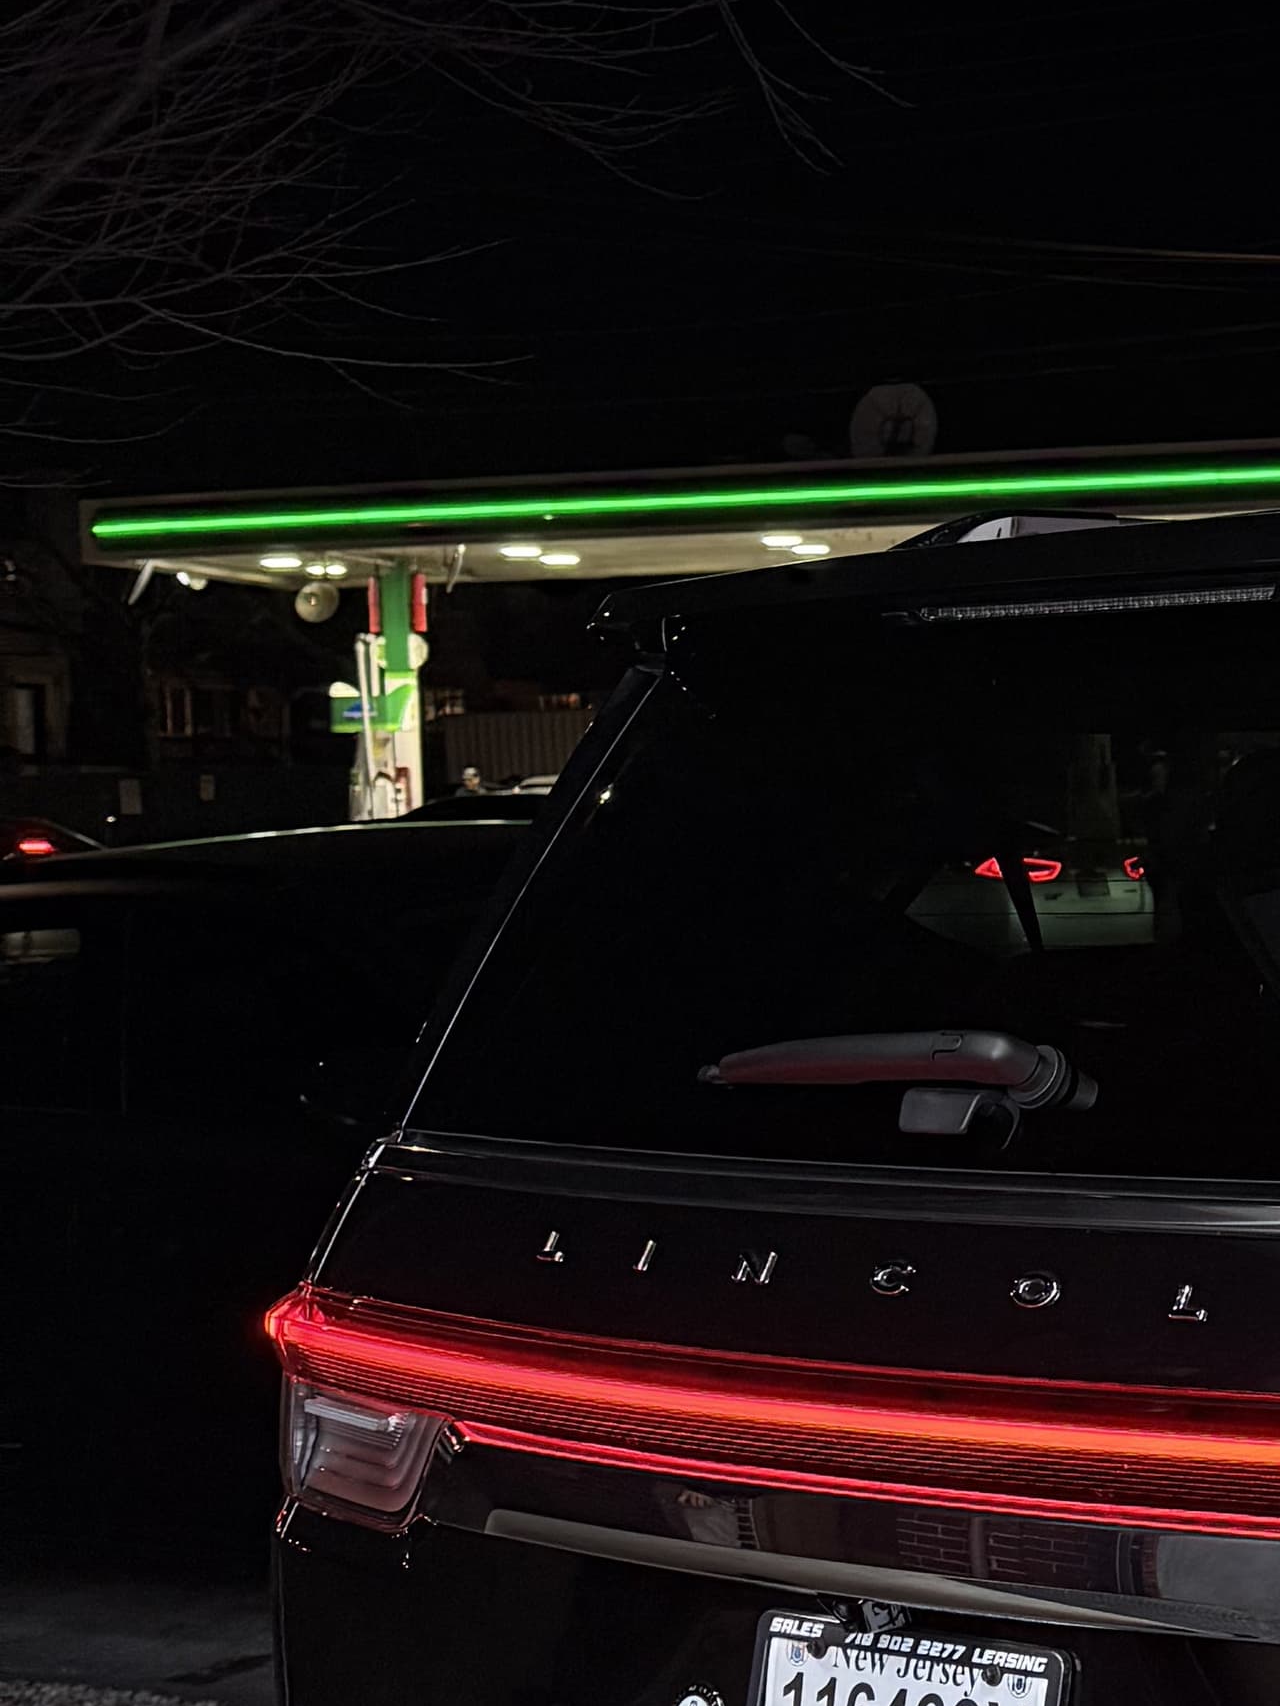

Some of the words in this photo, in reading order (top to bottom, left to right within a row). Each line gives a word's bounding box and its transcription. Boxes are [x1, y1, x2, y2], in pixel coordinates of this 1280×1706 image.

[769, 1616, 825, 1639] SALES
[832, 1646, 890, 1676] New
[896, 1655, 981, 1697] Jersey
[877, 1633, 915, 1653] 902
[916, 1639, 967, 1661] 2277
[971, 1647, 1049, 1674] LEASING
